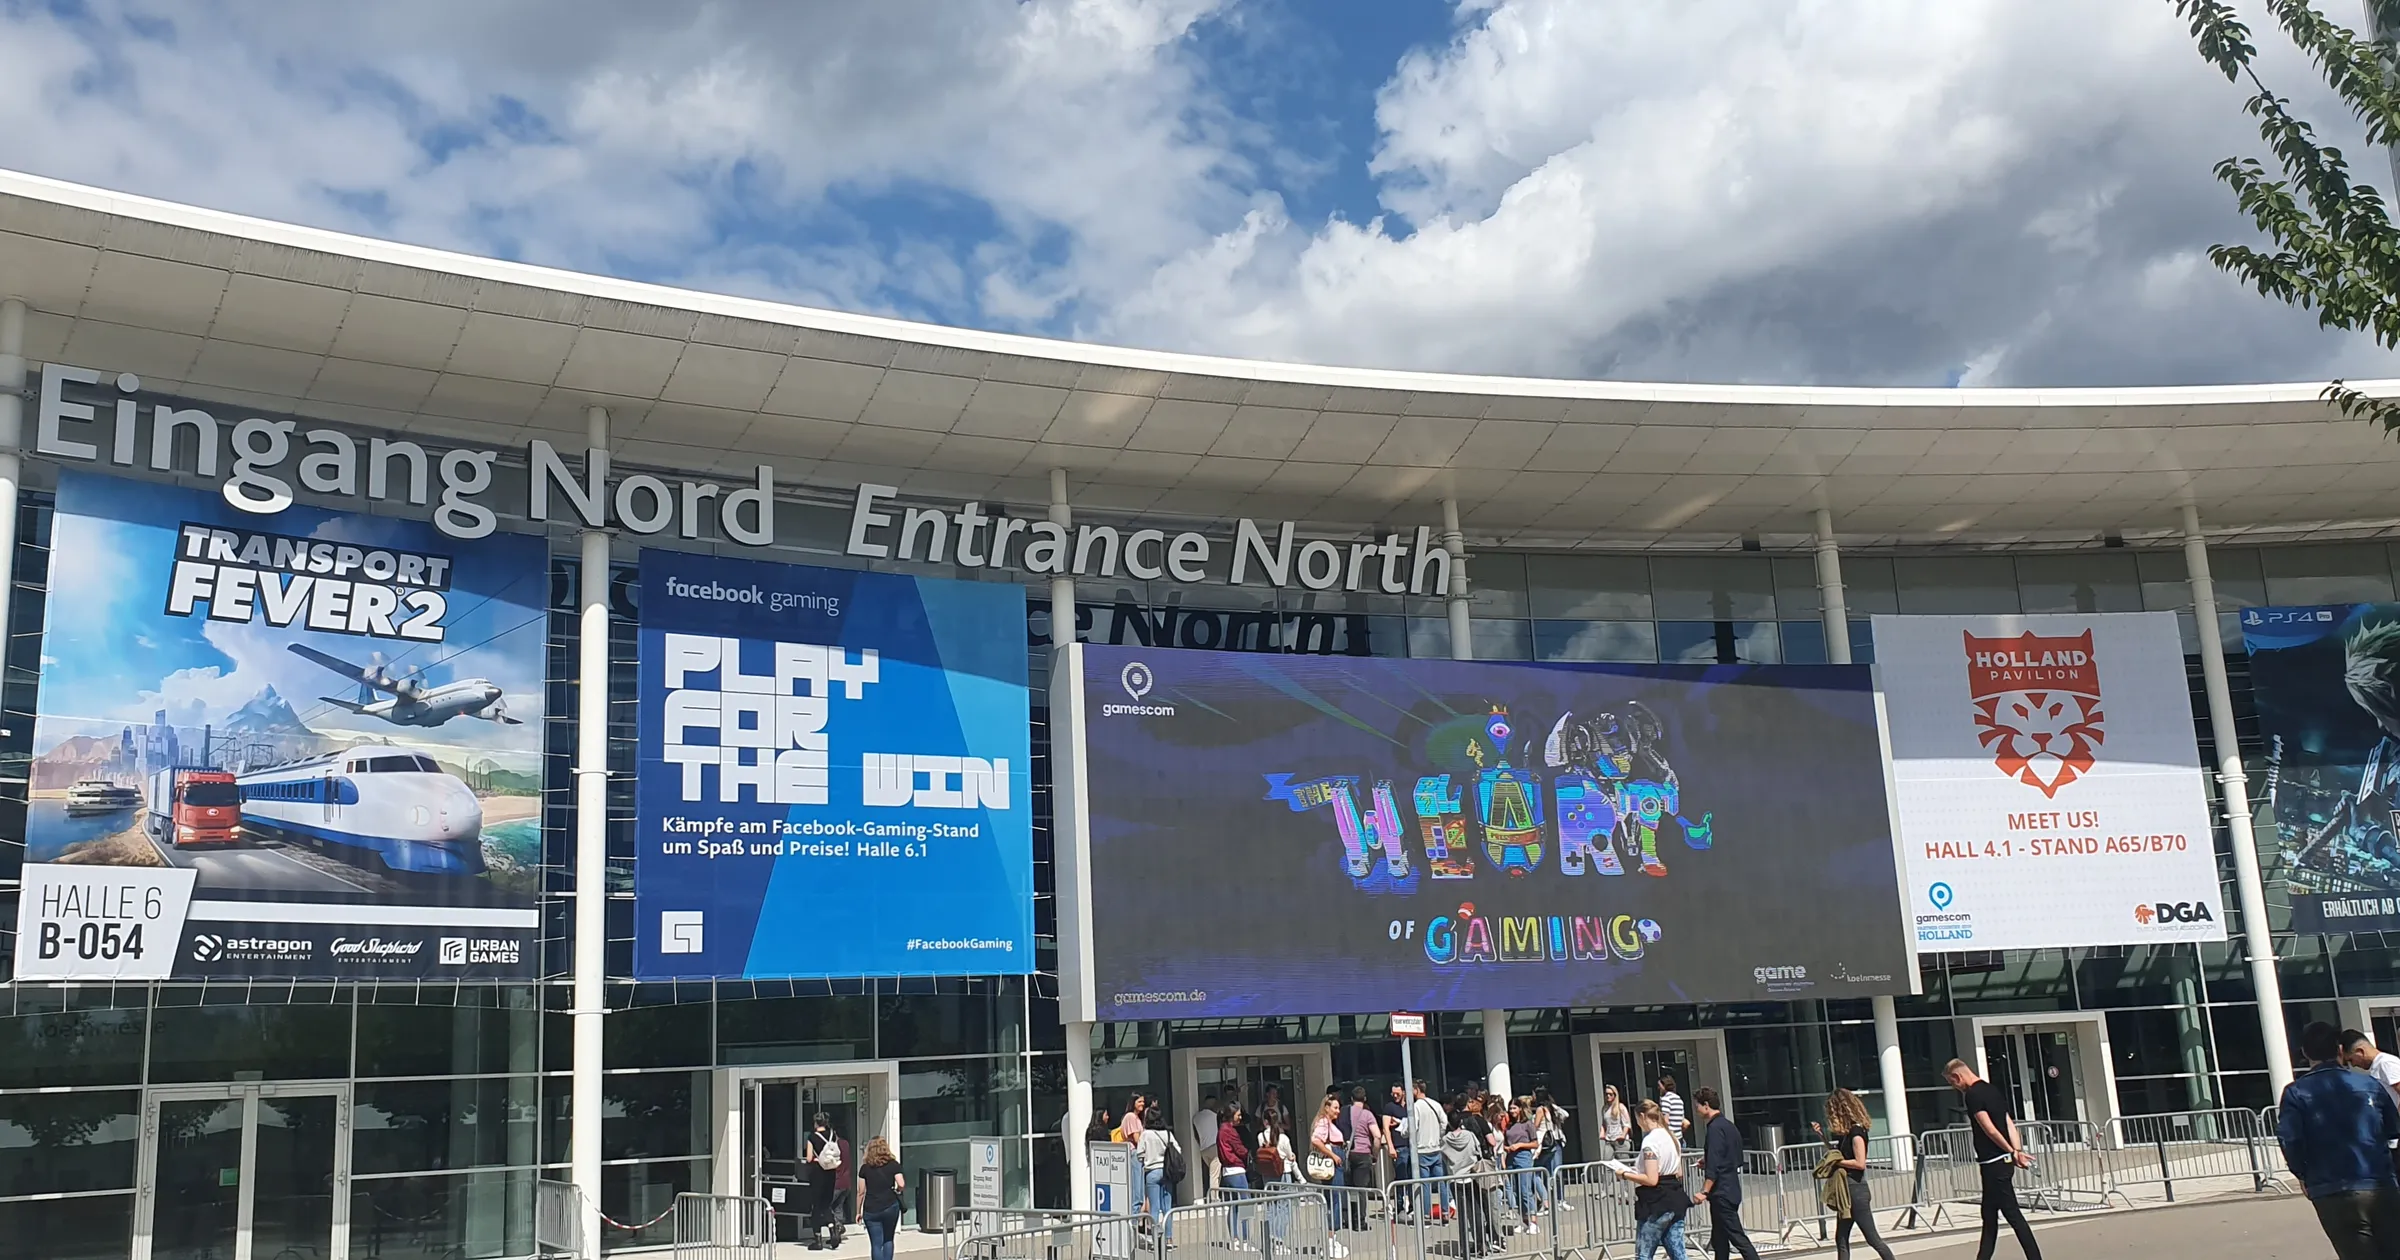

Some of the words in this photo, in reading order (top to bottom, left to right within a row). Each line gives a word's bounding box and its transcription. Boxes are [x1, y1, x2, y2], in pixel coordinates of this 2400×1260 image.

[36, 363, 498, 540] Eingang
[527, 438, 774, 546] Nord
[846, 482, 1209, 583] Entrance
[1230, 517, 1452, 596] North
[182, 525, 451, 589] TRANSPORT
[168, 564, 399, 637] FEVER
[400, 590, 447, 641] 2
[666, 576, 763, 605] facebook
[769, 590, 839, 616] gaming
[2268, 612, 2314, 624] PS4
[664, 632, 879, 700] PLAY
[1975, 650, 2088, 668] HOLLAND
[1990, 669, 2079, 681] PAVILION
[664, 688, 828, 751] FOR
[1102, 703, 1175, 717] gamescom
[664, 744, 828, 804] THE
[863, 752, 1010, 810] WIN
[662, 816, 734, 836] Kämpfe
[738, 822, 766, 835] am
[771, 819, 979, 840] Facebook-Gaming-Stand
[2007, 812, 2061, 831] MEET
[2067, 811, 2099, 828] US!
[662, 843, 692, 856] um
[697, 840, 745, 859] Spaß
[749, 841, 784, 856] und
[789, 842, 850, 857] Preise!
[857, 842, 900, 857] Halle
[904, 844, 928, 858] 6.1
[1925, 841, 1979, 860] HALL
[1984, 839, 2012, 857] 4.1
[2030, 837, 2099, 857] STAND
[2105, 834, 2187, 854] A65/B70
[41, 883, 138, 920] HALLE
[143, 886, 163, 920] 6
[2322, 898, 2380, 918] ERHÄLTLICH
[2381, 898, 2395, 916] AB
[1915, 913, 1972, 925] gamescom
[2155, 901, 2214, 924] DGA
[38, 922, 145, 961] B-054
[469, 939, 520, 951] URBAN
[906, 936, 1013, 952] #FacebookGaming
[1388, 919, 1415, 941] OF
[1424, 912, 1645, 964] GAMING
[1918, 929, 1973, 941] HOLLAND
[226, 937, 313, 955] astragon
[330, 937, 366, 957] Good
[226, 953, 313, 961] ENTERTAINMENT
[469, 951, 520, 964] GAMES
[1753, 965, 1806, 984] game
[1113, 988, 1207, 1007] gamescom.de
[1097, 1187, 1106, 1211] P
